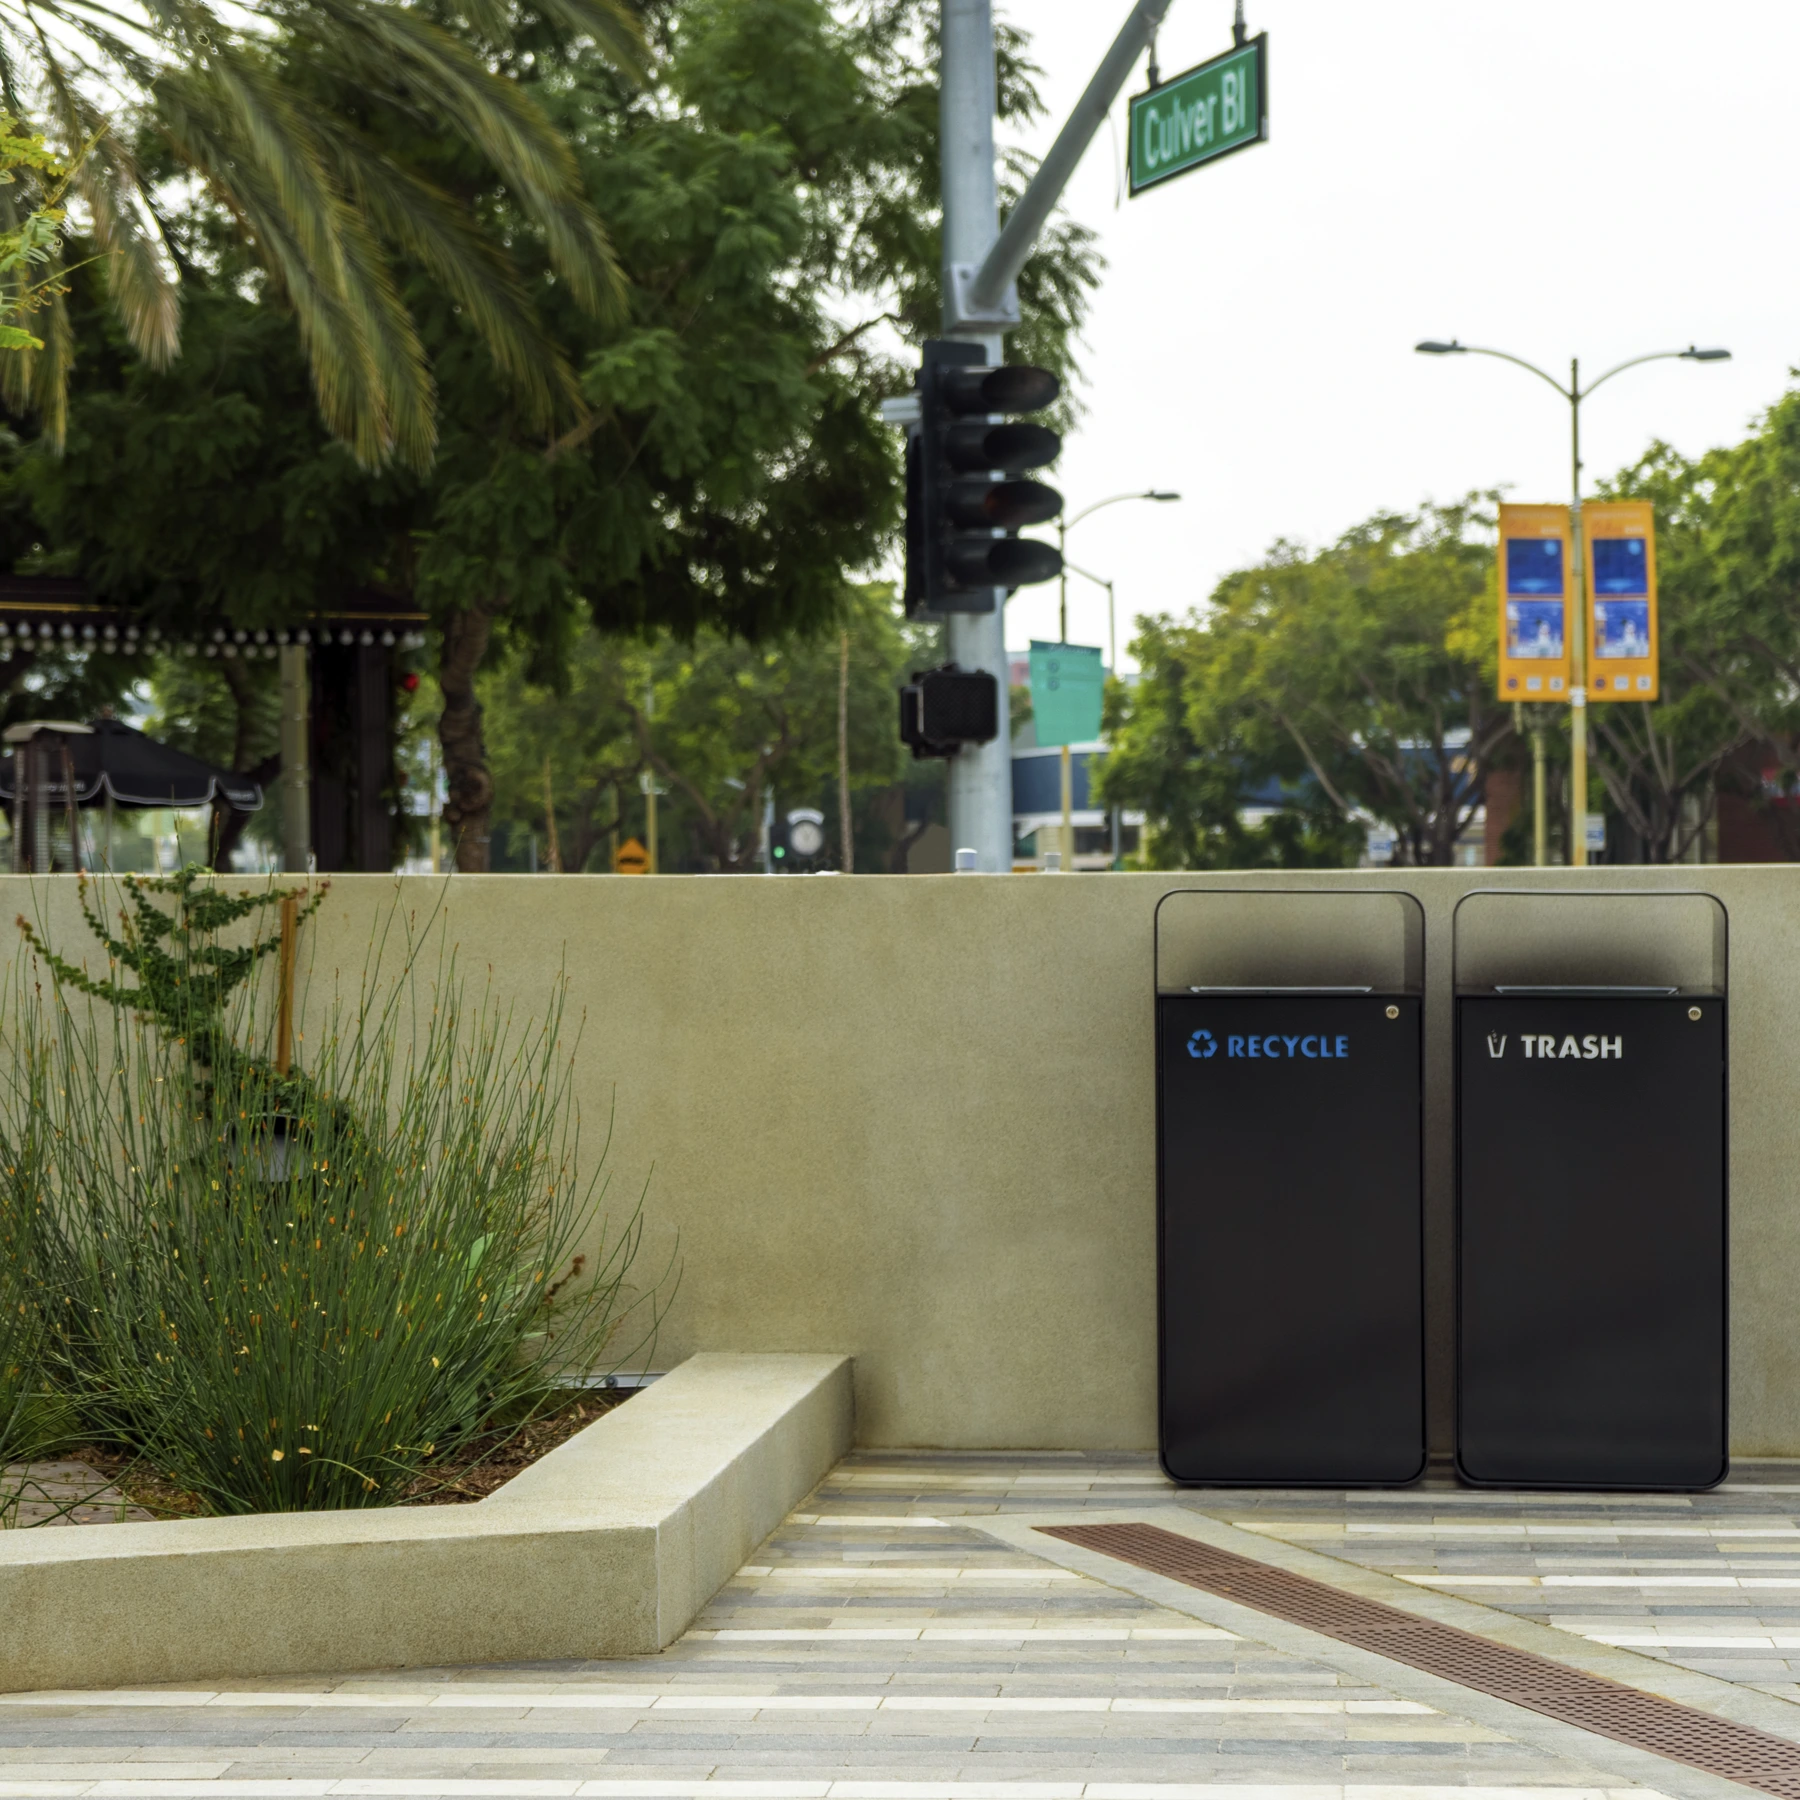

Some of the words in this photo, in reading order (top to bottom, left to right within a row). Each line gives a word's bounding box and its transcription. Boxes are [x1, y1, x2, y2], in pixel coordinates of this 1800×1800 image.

[1144, 95, 1218, 169] Culver
[1221, 65, 1246, 136] Bl
[1227, 1035, 1348, 1058] RECYCLE
[1521, 1035, 1622, 1059] TRASH
